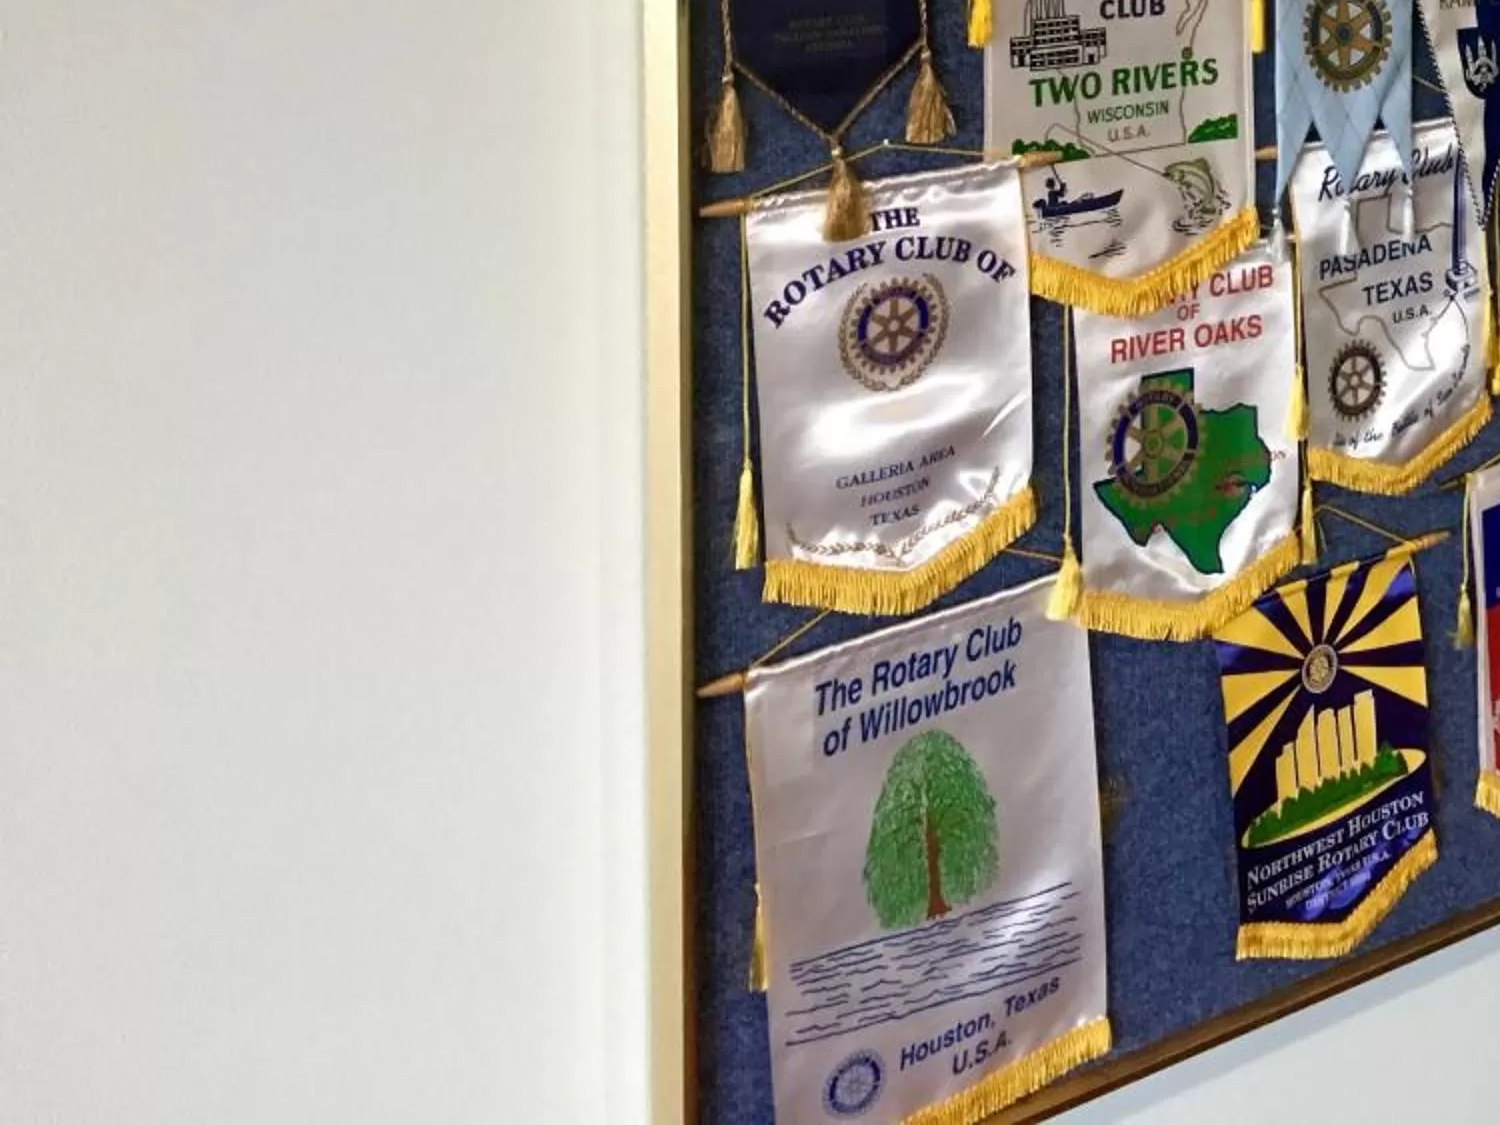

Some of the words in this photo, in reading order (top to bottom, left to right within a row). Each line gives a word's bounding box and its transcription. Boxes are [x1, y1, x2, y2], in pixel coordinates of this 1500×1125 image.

[1029, 75, 1102, 108] TWO
[1112, 57, 1219, 97] RIVERS
[1087, 101, 1170, 124] WISCONSIN
[1108, 124, 1151, 143] U.S.A.
[1318, 166, 1400, 202] Roary
[869, 207, 921, 231] THE
[1319, 234, 1433, 281] PASADENA
[763, 240, 887, 329] ROTARY
[895, 236, 971, 263] CLUB
[977, 251, 1017, 283] OF
[1210, 264, 1274, 298] CLUB
[1362, 272, 1433, 306] TEXAS
[1177, 304, 1201, 322] OF
[1392, 306, 1432, 325] U.S.A.
[1111, 327, 1186, 364] RIVER
[1195, 314, 1263, 349] OAKS
[836, 460, 914, 490] GALLERIA
[920, 445, 956, 467] AREA
[861, 478, 931, 508] HOUSTON
[870, 506, 921, 527] TEXAS
[815, 677, 862, 716] The
[871, 644, 959, 697] Rotary
[966, 617, 1023, 662] Club
[823, 717, 854, 757] of
[859, 660, 1017, 743] Willowbrook
[1246, 864, 1315, 915] SUNRISE
[1317, 830, 1379, 876] ROTARY
[1382, 810, 1430, 842] CLUB
[1247, 827, 1345, 892] NORTHWEST
[1348, 791, 1425, 836] HOUSTON
[900, 1011, 996, 1072] Houston,
[1003, 977, 1061, 1017] Texas
[952, 1031, 1014, 1076] U.S.A.
